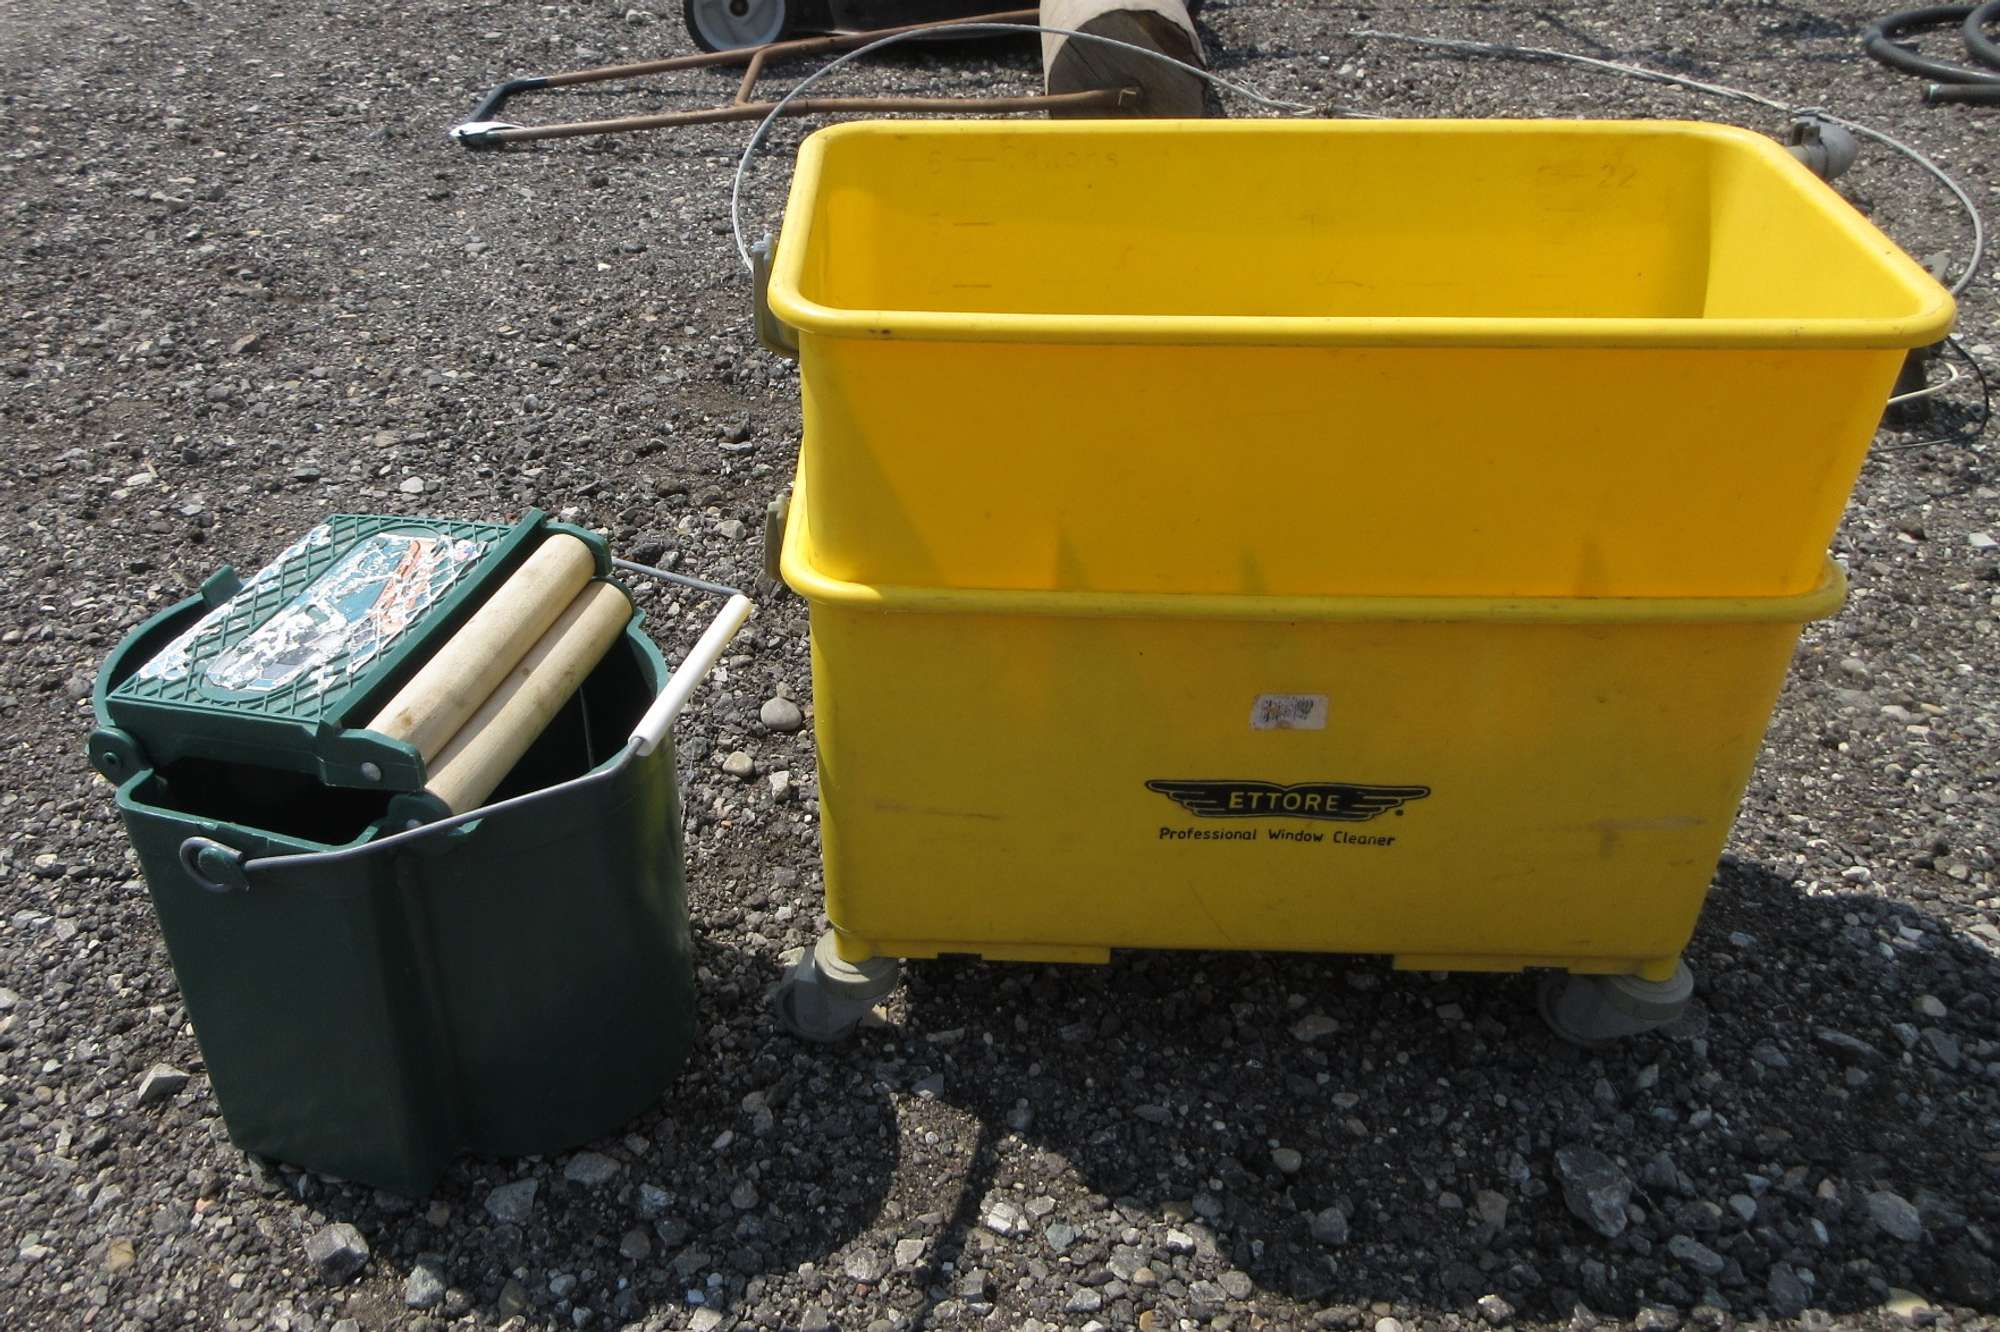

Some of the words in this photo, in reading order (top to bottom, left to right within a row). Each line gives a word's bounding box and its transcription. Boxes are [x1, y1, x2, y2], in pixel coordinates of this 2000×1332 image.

[1228, 791, 1341, 812] ETTORE
[1159, 827, 1257, 842] Professional
[1268, 828, 1323, 843] Window
[1333, 831, 1396, 847] Cleaner
